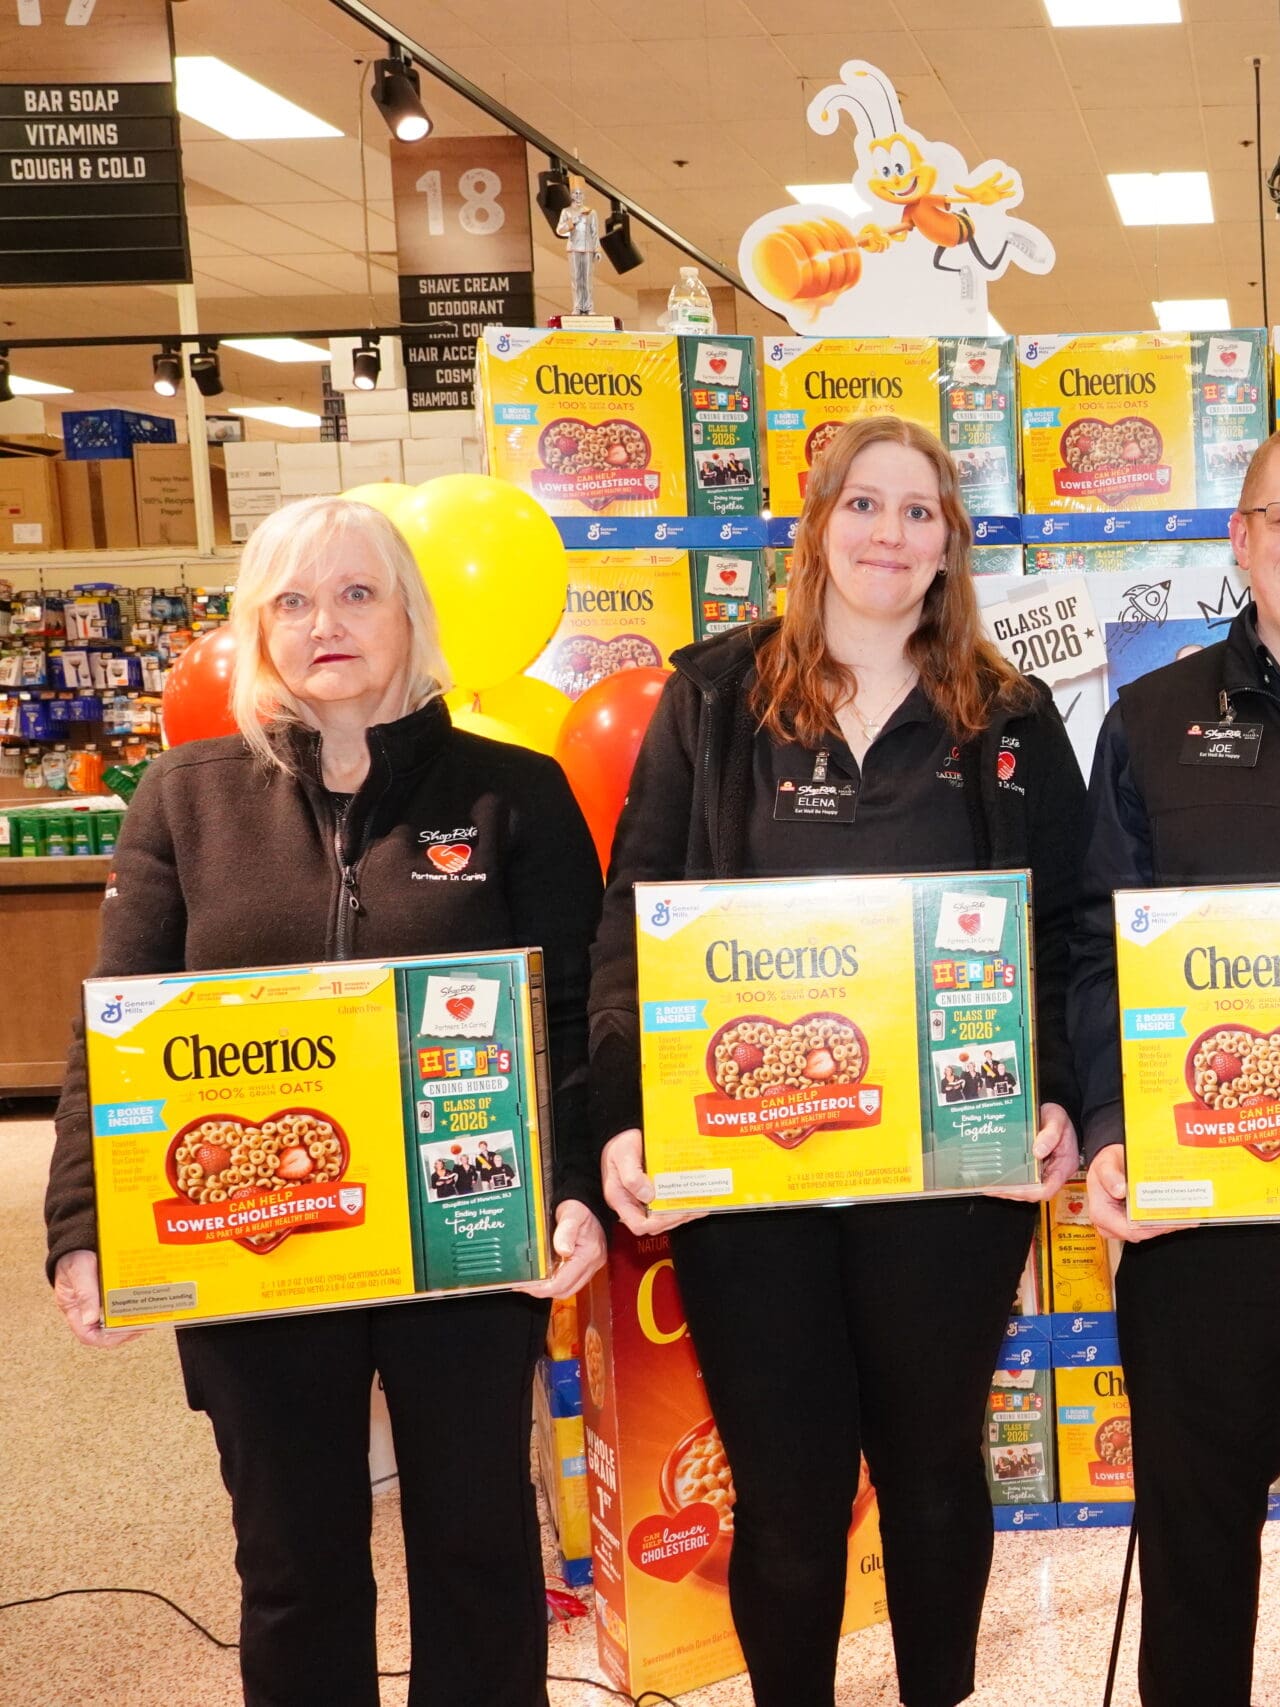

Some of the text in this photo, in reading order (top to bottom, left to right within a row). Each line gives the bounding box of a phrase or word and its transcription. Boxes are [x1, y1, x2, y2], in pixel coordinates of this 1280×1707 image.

[24, 89, 119, 112] BAR SOAP
[25, 124, 118, 146] VITAMINS
[10, 157, 146, 180] COUGH & COLD
[415, 168, 505, 236] 18
[419, 276, 509, 295] SHAVE CREAM
[428, 299, 504, 316] DEODORANT
[463, 322, 503, 338] COL
[409, 347, 439, 363] HAIR
[536, 365, 643, 397] Cheerios
[805, 370, 903, 400] Cheerios
[1060, 367, 1156, 397] Cheerios
[412, 391, 459, 407] SHAMPOO
[461, 391, 468, 406] &
[538, 477, 643, 493] LOWER CHOLESTEROL
[1060, 473, 1155, 491] LOWER CHOLESTEROL
[564, 583, 654, 613] heerios
[994, 597, 1078, 641] CLASS OF
[1011, 624, 1084, 674] 2026
[1208, 743, 1233, 753] JOE
[797, 797, 836, 808] ELENA
[417, 826, 478, 845] ShopRite
[411, 871, 487, 882] Partners In Caring
[706, 937, 859, 983] Cheerios
[125, 998, 156, 1009] General
[736, 987, 847, 1003] 100% OATS
[941, 991, 1008, 1004] ENDING HUNGER
[125, 1006, 144, 1015] Mills
[656, 1005, 696, 1016] 2 BOXES
[1214, 998, 1256, 1012] 100%
[656, 1013, 696, 1024] INSIDE!
[953, 1009, 997, 1022] CLASS OF
[1135, 1014, 1142, 1023] 2
[959, 1021, 993, 1040] 2026
[1136, 1021, 1176, 1032] INSIDE!
[163, 1028, 337, 1082] Cheerios
[198, 1080, 324, 1102] 100% OATS
[429, 1079, 504, 1096] ENDING HUNGER
[443, 1097, 492, 1113] CLASS OF
[761, 1090, 818, 1109] CAN HELP
[108, 1105, 154, 1117] 2 BOXES
[706, 1096, 856, 1126] LOWER CHOLESTEROL
[1239, 1108, 1265, 1120] CAN
[108, 1115, 153, 1128] INSIDE!
[450, 1110, 489, 1132] 2026
[1185, 1122, 1236, 1136] LOWER
[952, 1120, 1007, 1142] Together
[229, 1190, 294, 1213] CAN HELP
[166, 1197, 337, 1234] LOWER CHOLESTEROL
[205, 1231, 216, 1240] AS
[216, 1228, 234, 1239] PART
[234, 1226, 243, 1237] OF
[251, 1221, 274, 1233] HEART
[275, 1215, 303, 1229] HEALTHY
[304, 1211, 319, 1222] DIET
[444, 1215, 506, 1239] Together
[1006, 1431, 1028, 1443] 2026
[586, 1426, 616, 1469] WHOLE
[588, 1447, 617, 1493] GRAIN
[1095, 1471, 1126, 1481] LOWER
[643, 1523, 706, 1545] CAN lower
[641, 1537, 710, 1564] CHOLESTEROL
[642, 1538, 663, 1550] HELP
